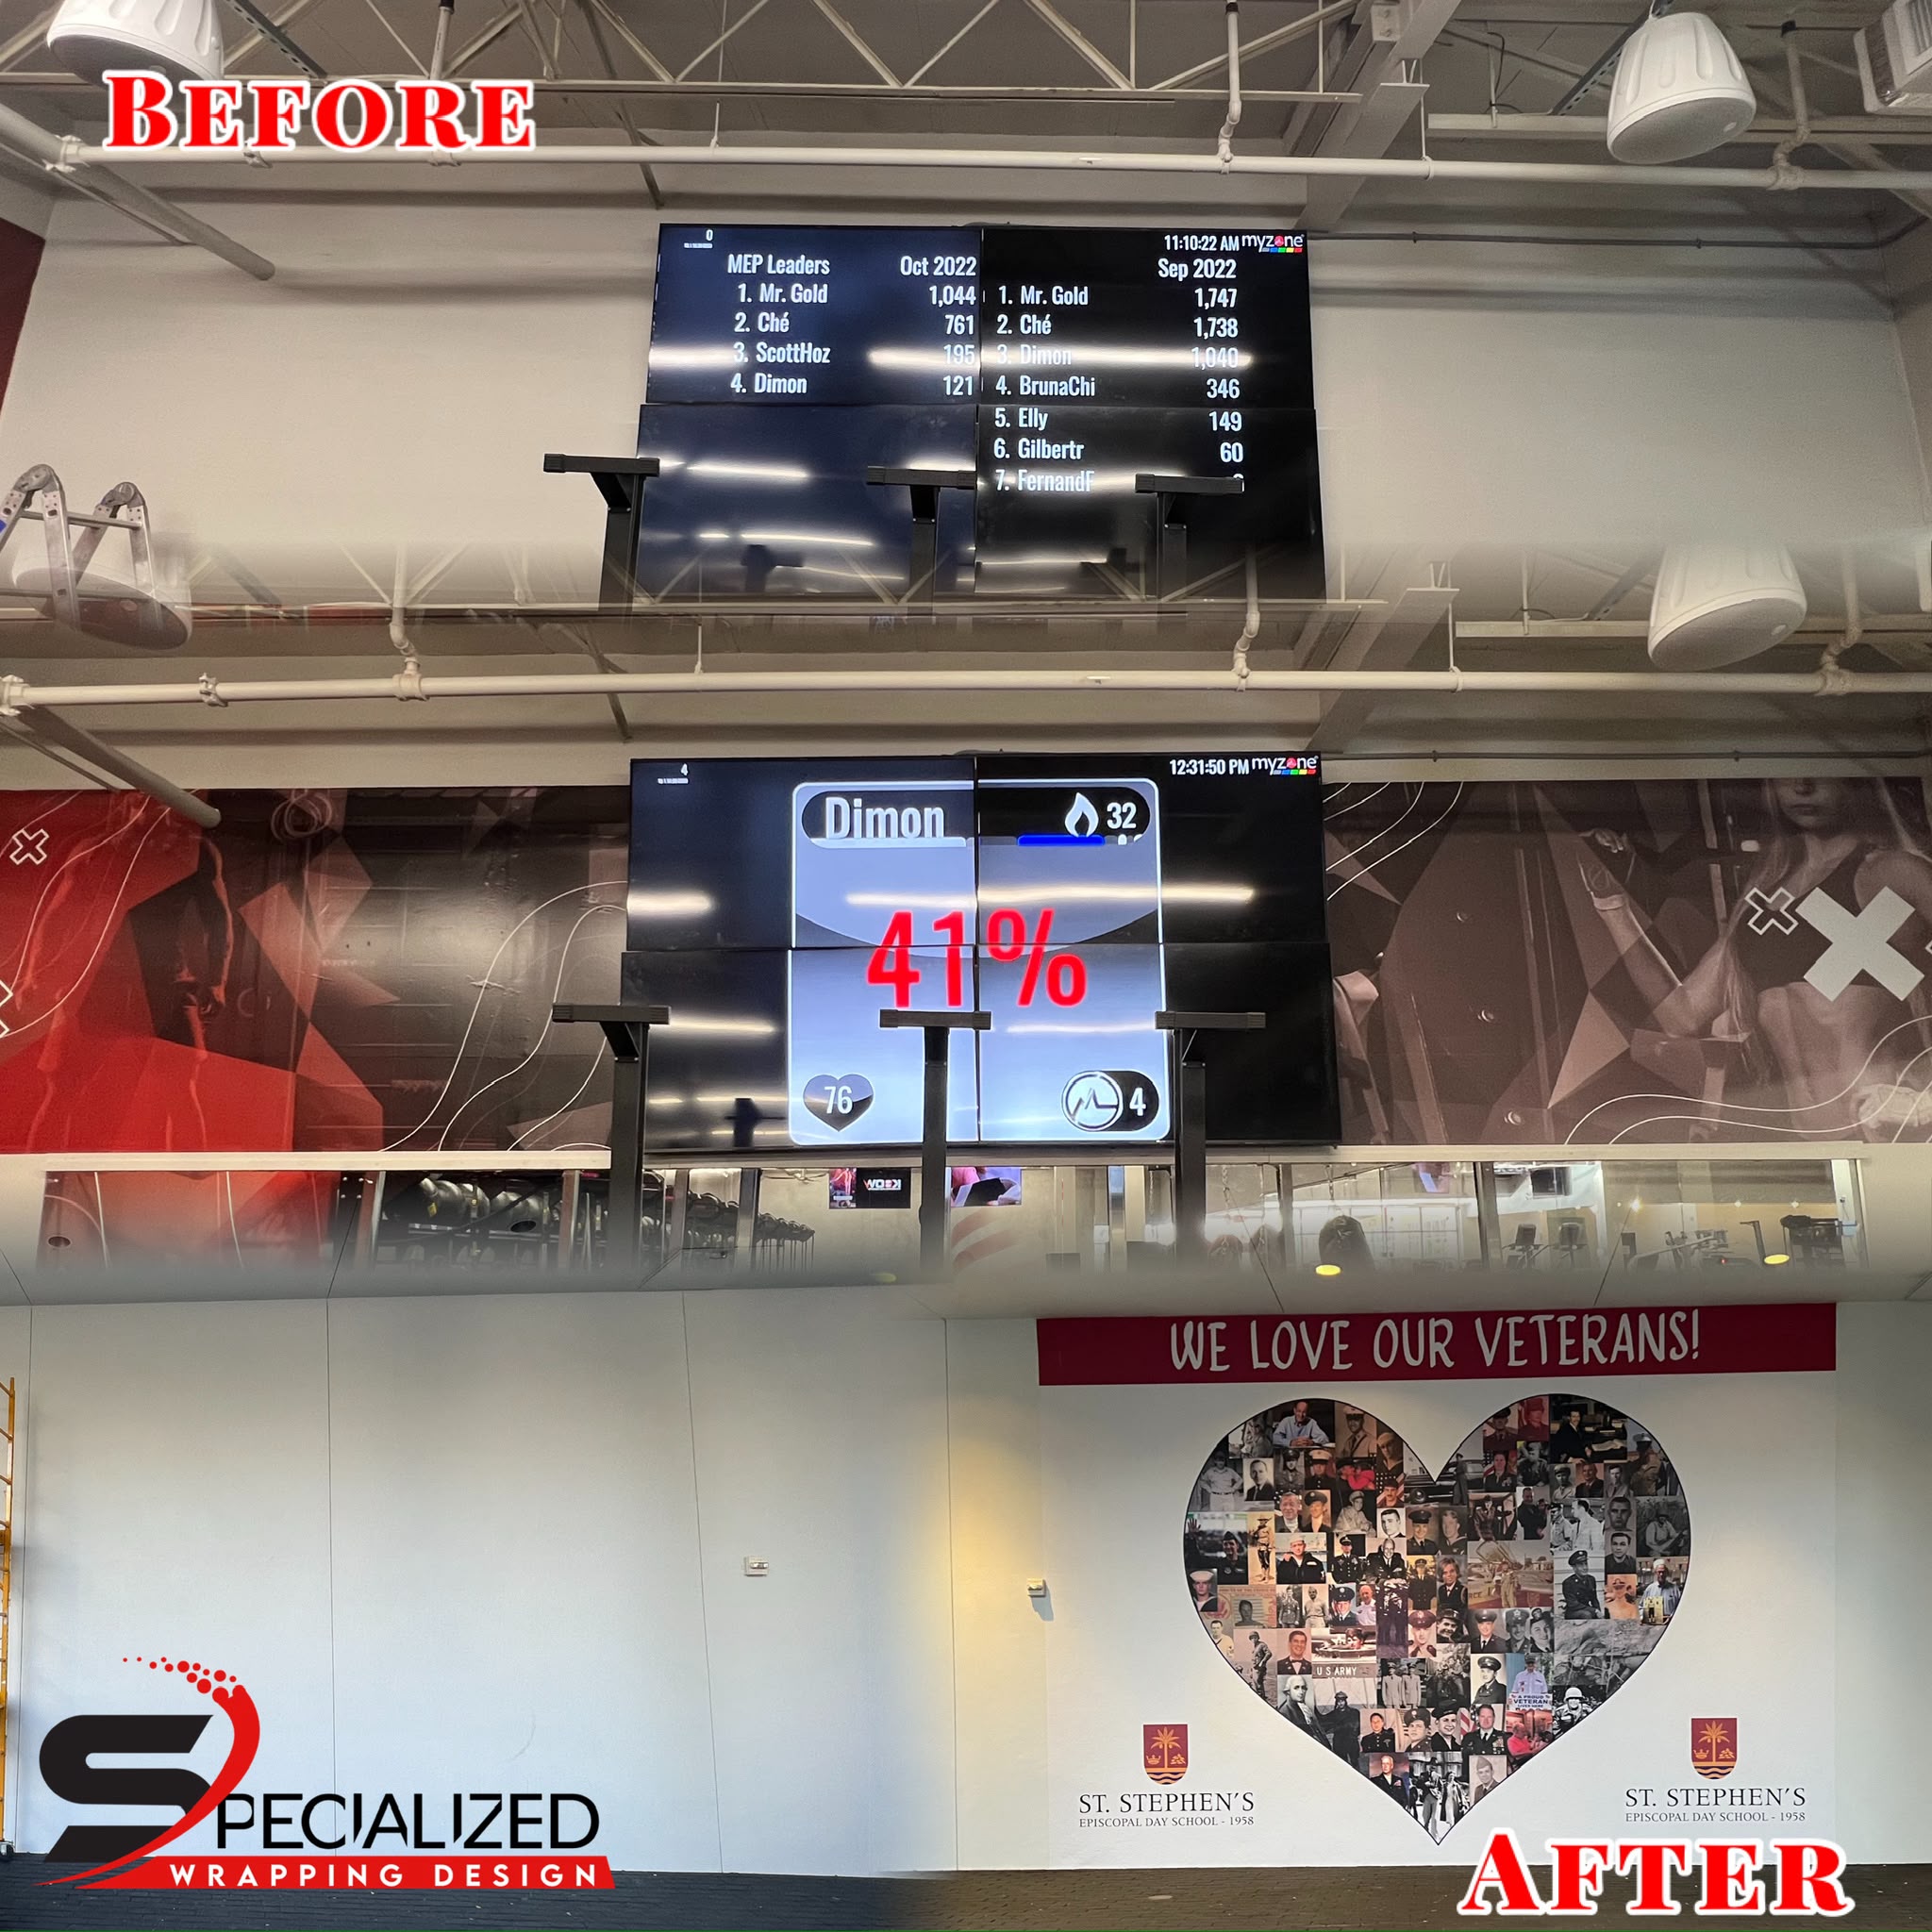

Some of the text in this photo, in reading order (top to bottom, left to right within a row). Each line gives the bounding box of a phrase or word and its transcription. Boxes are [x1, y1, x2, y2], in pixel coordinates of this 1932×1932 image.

[1164, 234, 1240, 252] 11:10:22 AM
[727, 254, 830, 275] MEP Leaders
[900, 256, 977, 276] Oct 2022
[1158, 258, 1237, 281] Sep 2022
[738, 283, 976, 308] 1. Mr. Gold 1,044
[998, 286, 1238, 310] 1. Mr. Gold 1,747
[734, 311, 974, 336] 2. Ché 761
[997, 313, 1239, 340] 2. Ché 1,738
[733, 341, 975, 366] 3. ScottHoz 195
[997, 344, 1239, 371] 3. Dimon 1,040
[730, 373, 974, 396] 4. Dimon 121
[995, 375, 1241, 400] 4. BrunaChi 346
[994, 407, 1242, 432] 5. Elly 149
[993, 438, 1243, 463] 6. Gilbertr 60
[995, 470, 1095, 492] 7. FernandF
[1169, 759, 1250, 775] 12:31:50 PM
[825, 796, 944, 840] Dimon
[1106, 802, 1137, 829] 32
[866, 907, 1088, 1008] 41%
[824, 1085, 853, 1114] 76
[1129, 1088, 1146, 1116] 4
[1170, 1308, 1700, 1373] WE LOVE OUR VETERANS!
[1334, 1666, 1357, 1676] ARMY
[1079, 1792, 1255, 1814] ST. STEPHEN'S
[1625, 1788, 1806, 1807] ST. STEPHEN'S
[1079, 1817, 1142, 1828] EPISCOPAL
[1145, 1817, 1169, 1827] DAY
[1172, 1816, 1218, 1826] SCHOOL
[1229, 1816, 1255, 1826] 1958
[1625, 1812, 1689, 1823] EPISCOPAL
[1692, 1812, 1716, 1822] DAY
[1719, 1812, 1769, 1822] SCHOOL
[1780, 1812, 1806, 1822] 1958
